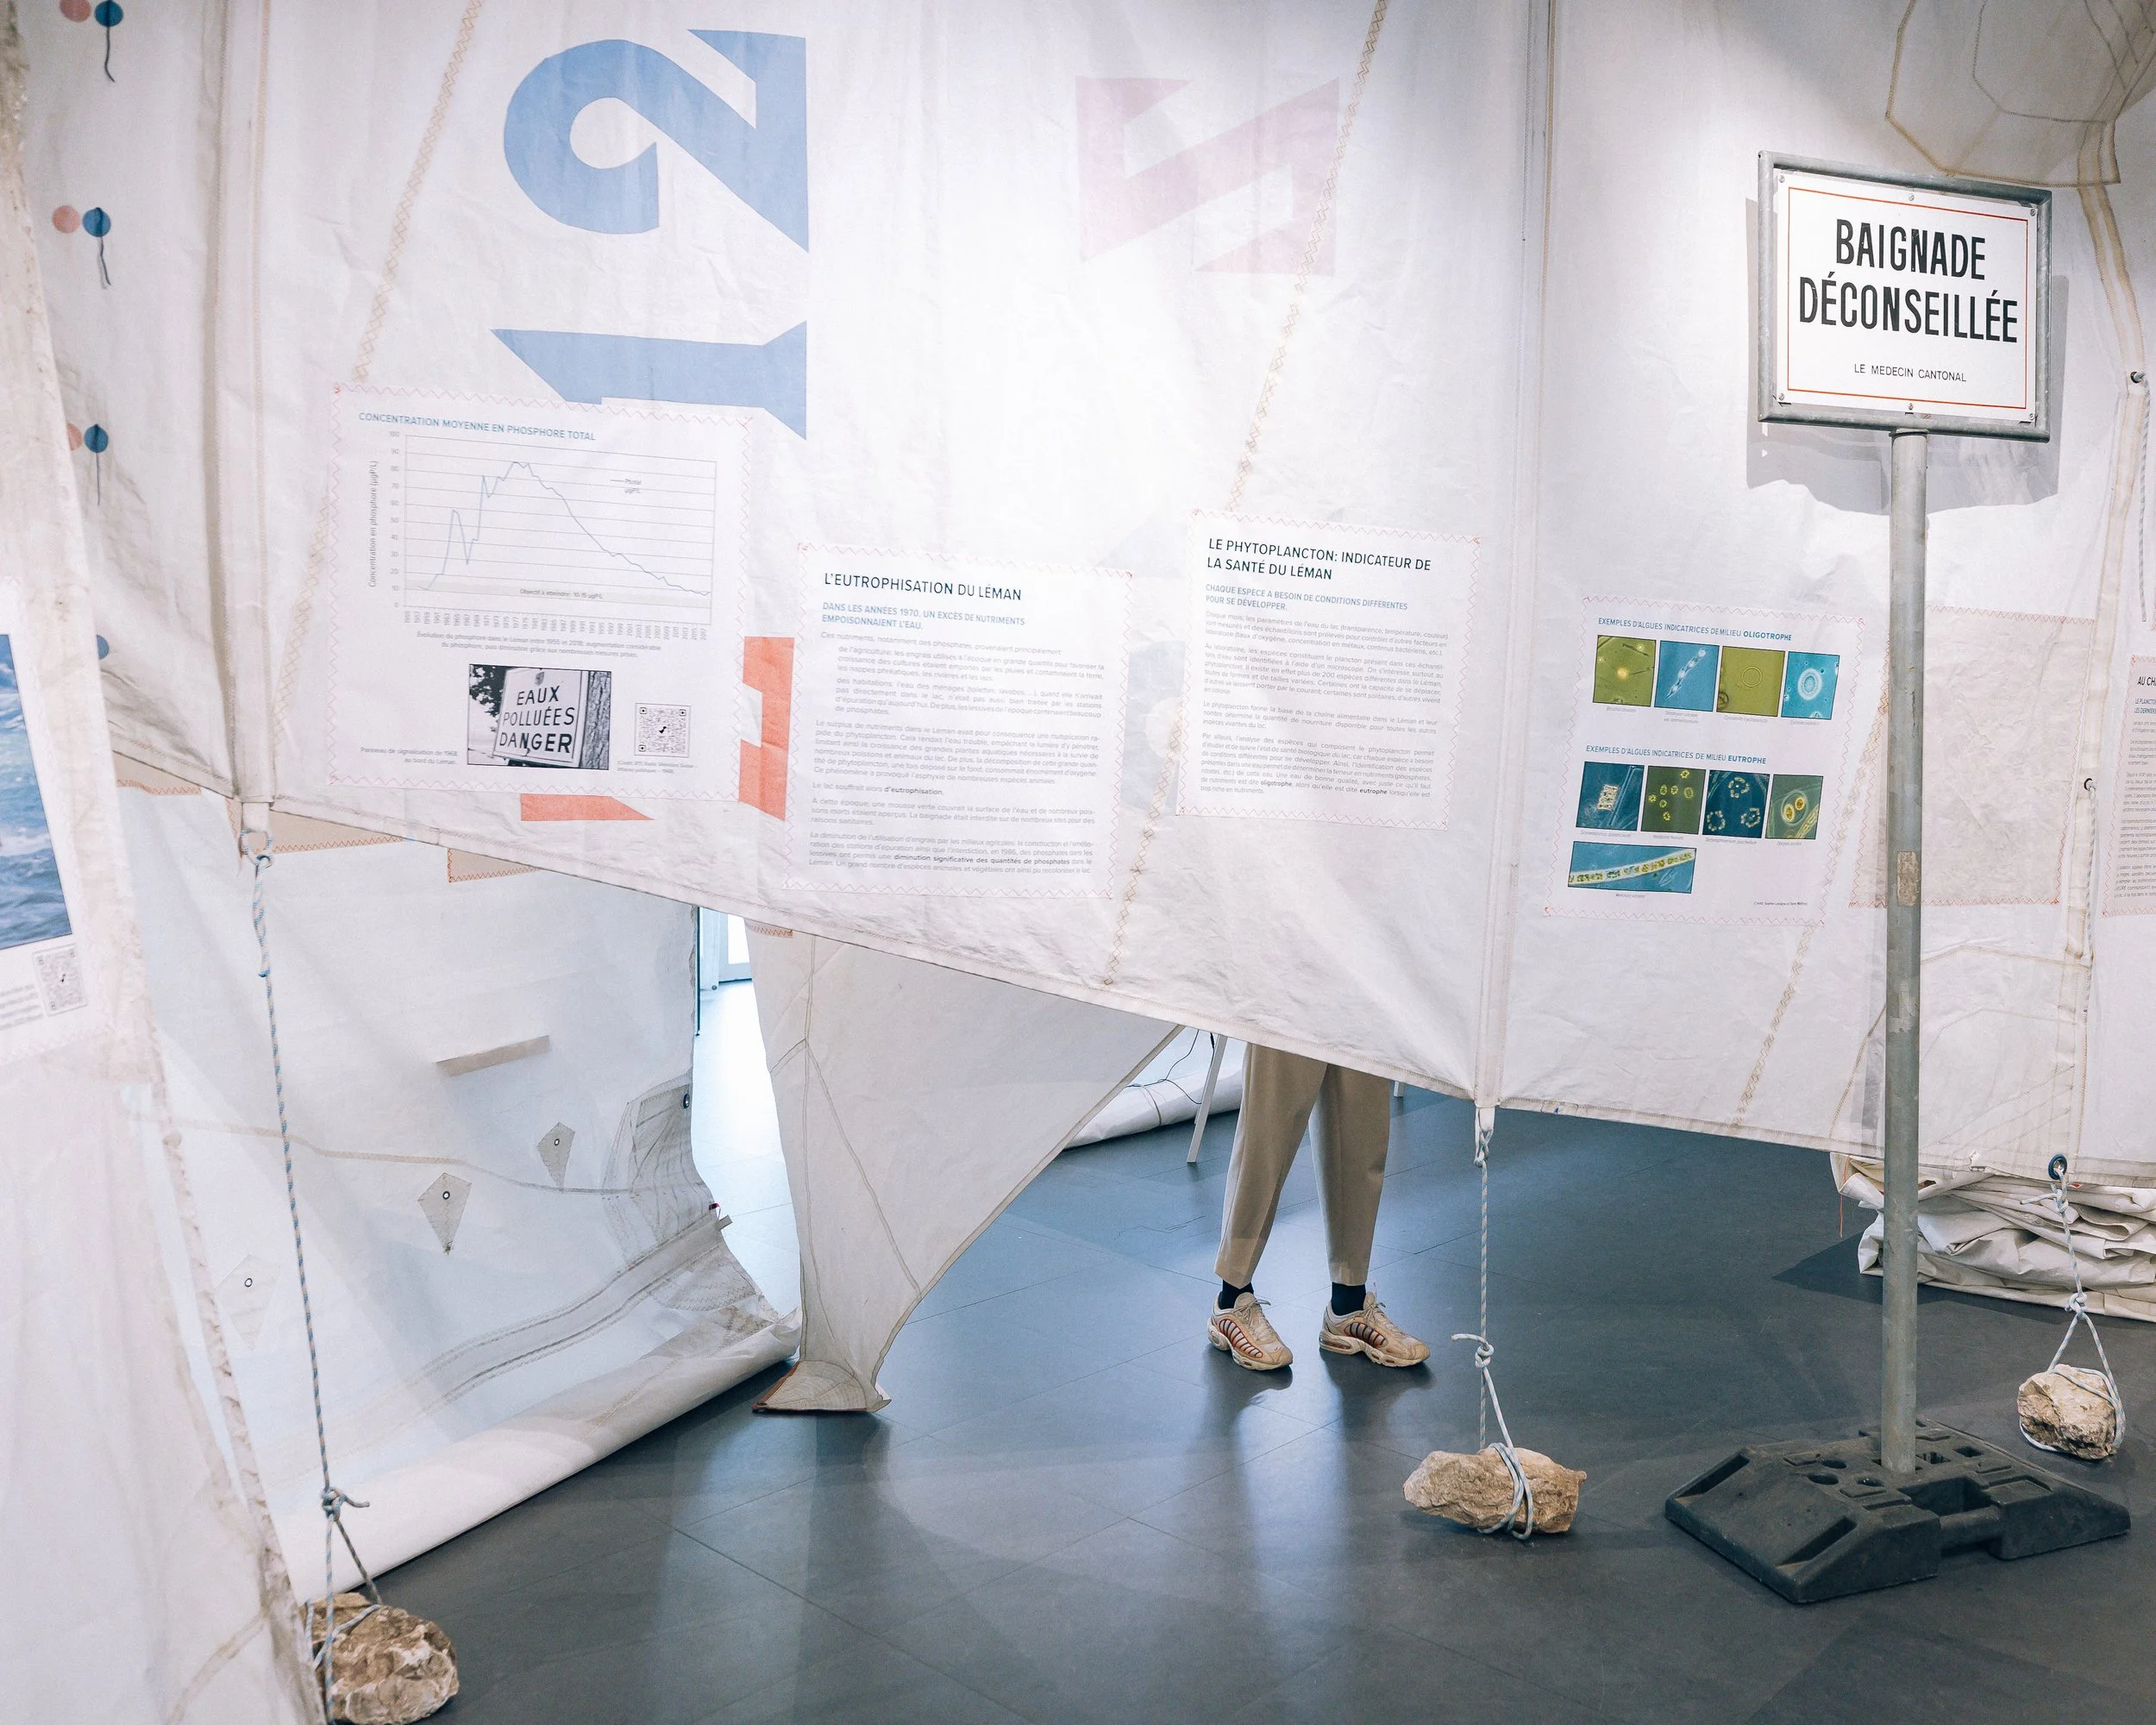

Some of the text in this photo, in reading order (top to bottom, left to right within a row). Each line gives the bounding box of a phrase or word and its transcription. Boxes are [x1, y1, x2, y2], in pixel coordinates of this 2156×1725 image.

[489, 29, 809, 440] 12
[1836, 219, 1985, 280] BAIGNADE
[1800, 271, 2018, 343] DÉCONSEILLÉE
[1854, 364, 1966, 382] LE MEDECIN CANTONAL
[359, 412, 596, 440] CONCENTRATION MOYENNE EN PHOSPHORE TOTAL
[368, 487, 378, 526] phosphore
[367, 538, 377, 587] Concentration
[1209, 537, 1431, 570] LE PHYTOPLANCTON: INDICATEUR DE
[1207, 555, 1332, 580] LA SANTÉ DU LÉMAN
[824, 571, 1021, 601] L'EUTROPHISATION DU LÉMAN
[1206, 584, 1237, 593] CHAQUE
[1274, 591, 1302, 600] BESOIN
[1315, 594, 1361, 605] CONDITIONS
[1206, 595, 1225, 604] POUR
[822, 601, 846, 611] DANS
[848, 604, 862, 612] LES
[923, 610, 936, 618] UN
[975, 614, 1025, 625] NUTRIMENTS
[822, 614, 896, 627] EMPOISONNAIENT
[1598, 617, 1631, 627] EXEMPLES
[1633, 620, 1663, 630] D'ALGUES
[1664, 624, 1709, 634] INDICATRICES
[1743, 630, 1791, 641] OLIGOTROPHE
[2137, 675, 2156, 686] AU CH
[517, 686, 560, 706] EAUX
[503, 706, 575, 726] POLLUÉES
[499, 732, 573, 753] DANGER
[1586, 744, 1620, 754] EXEMPLES
[1620, 747, 1651, 756] D'ALGUES
[1651, 750, 1693, 759] INDICATRICES
[1727, 755, 1766, 763] EUTROPHE
[1359, 786, 1388, 796] eutrophe
[933, 854, 974, 864] significative
[990, 856, 1021, 865] quantités
[1033, 857, 1070, 866] phosphates
